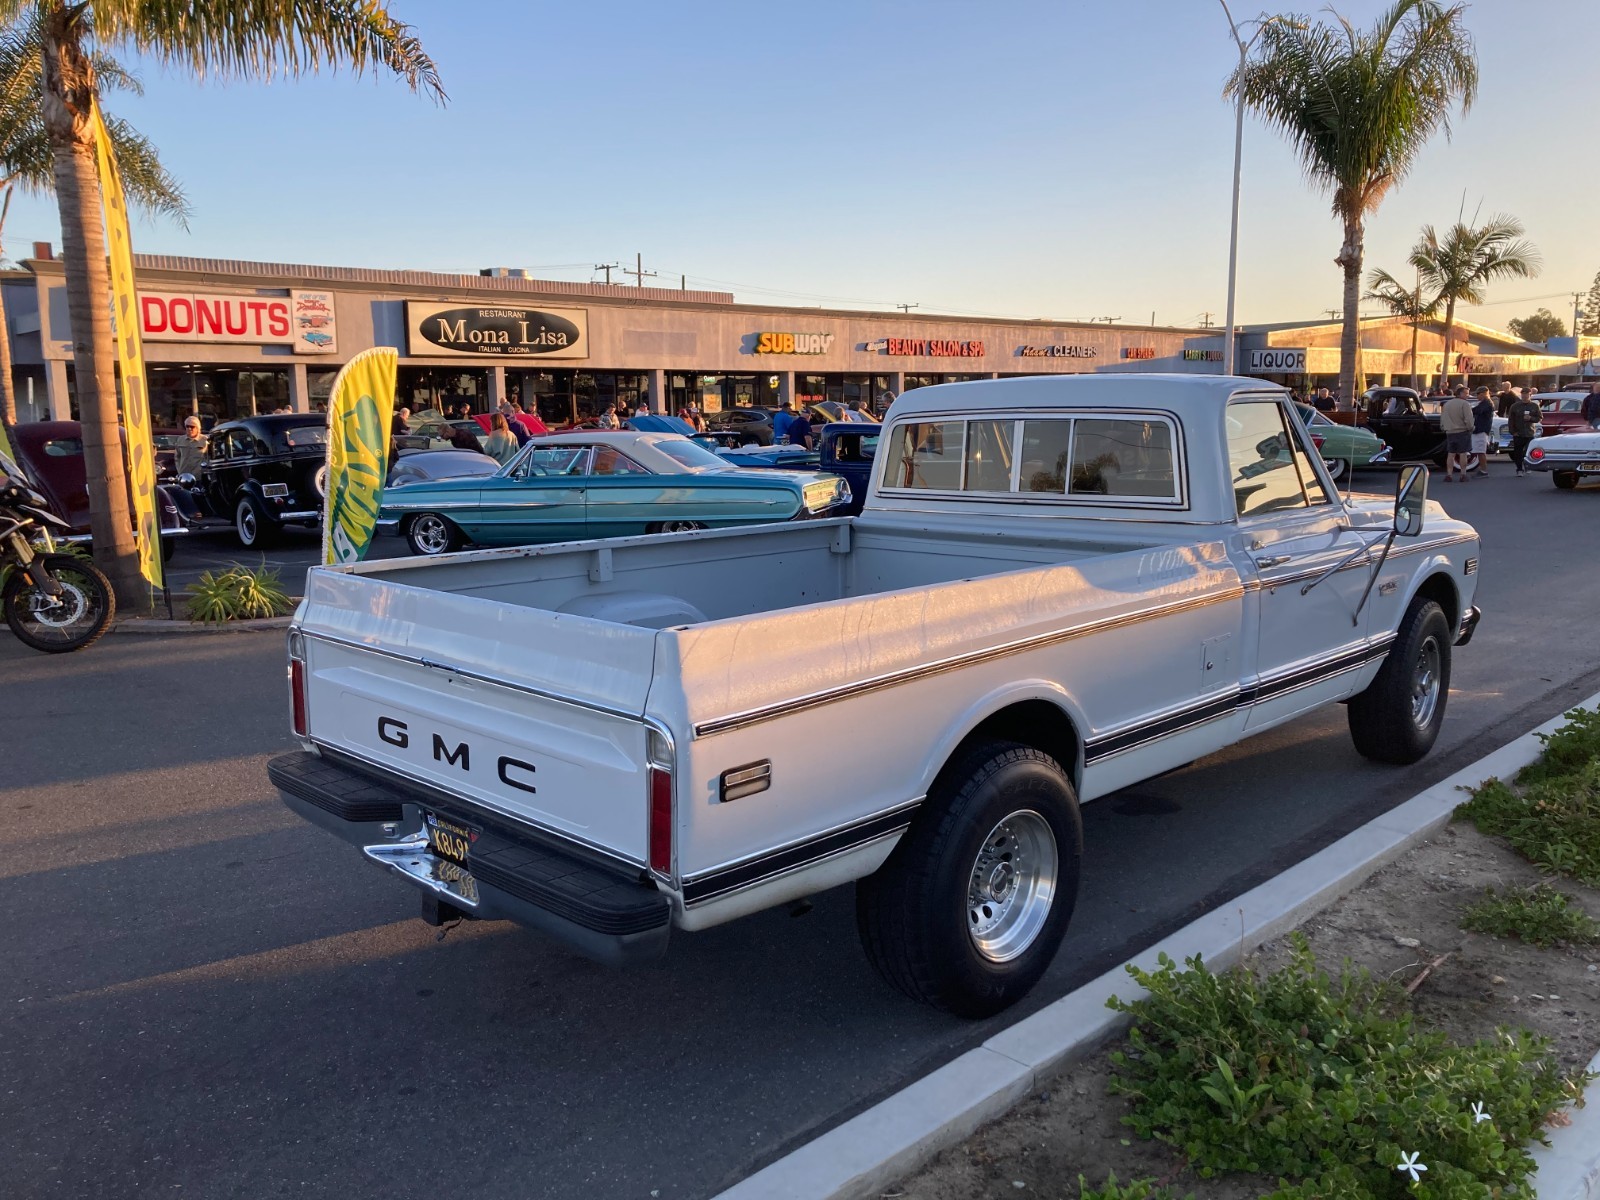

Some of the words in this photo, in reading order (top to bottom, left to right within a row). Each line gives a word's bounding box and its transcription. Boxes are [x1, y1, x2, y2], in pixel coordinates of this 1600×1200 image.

[141, 297, 290, 337] DONUTS
[479, 310, 526, 319] RESTAURANT
[436, 318, 510, 344] Mona
[518, 321, 568, 346] Lisa
[478, 345, 501, 353] ITALIAN
[758, 332, 835, 354] SUBWAY
[888, 338, 927, 355] BEAUTY
[930, 340, 961, 356] SALON
[962, 344, 968, 355] &
[969, 341, 985, 357] SPA
[1053, 345, 1098, 358] CLEANERS
[1251, 352, 1305, 368] LIQUOR
